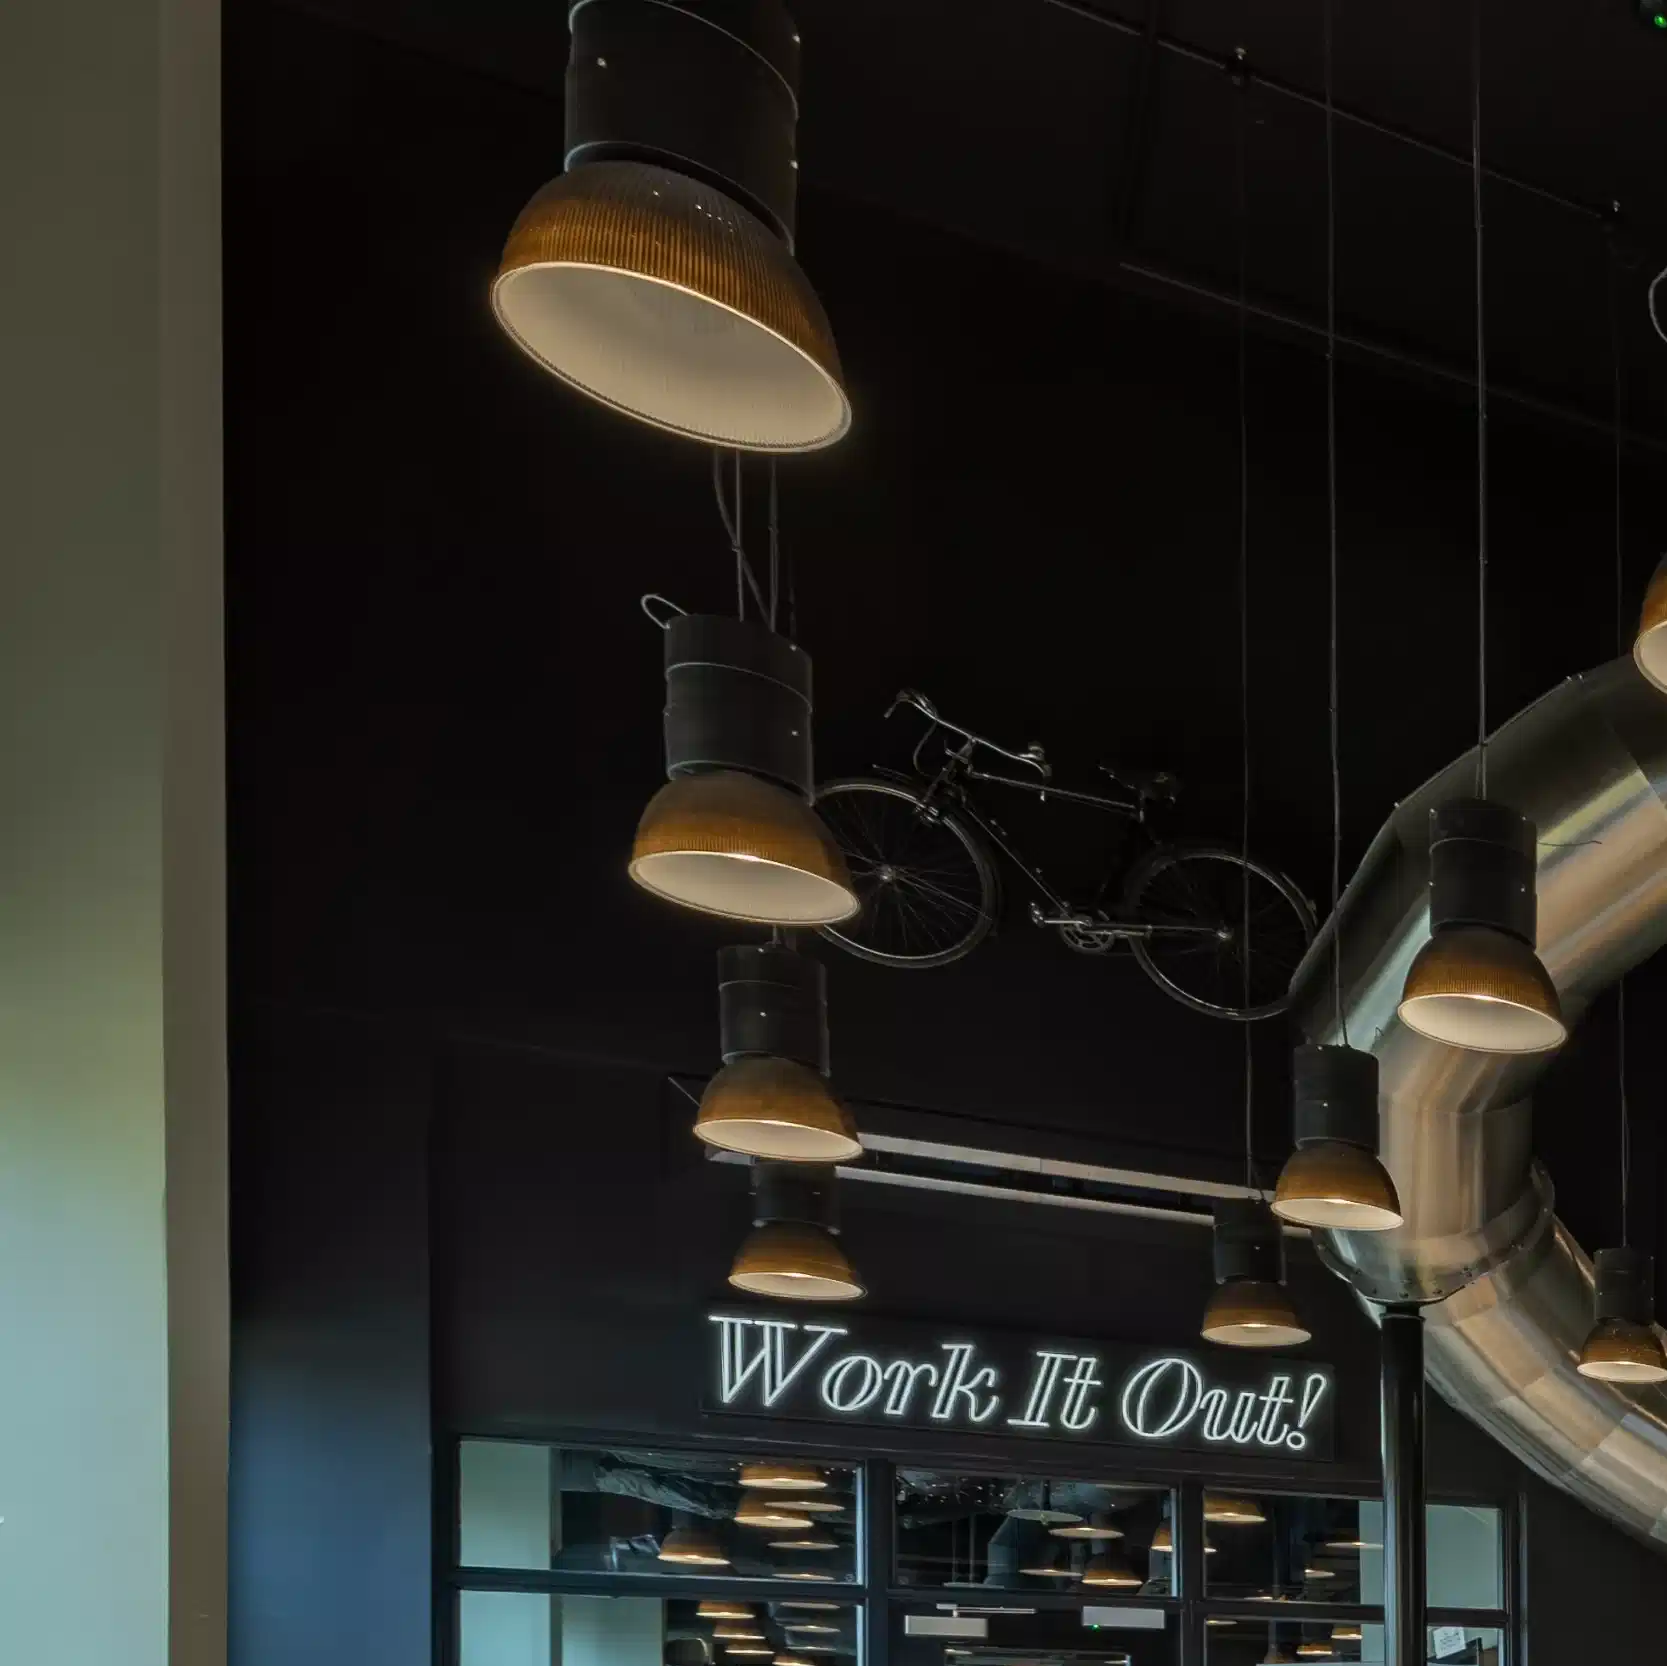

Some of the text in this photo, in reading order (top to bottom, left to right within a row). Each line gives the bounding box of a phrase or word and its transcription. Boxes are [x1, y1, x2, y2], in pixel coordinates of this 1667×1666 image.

[708, 1315, 1328, 1451] Work It Out!
